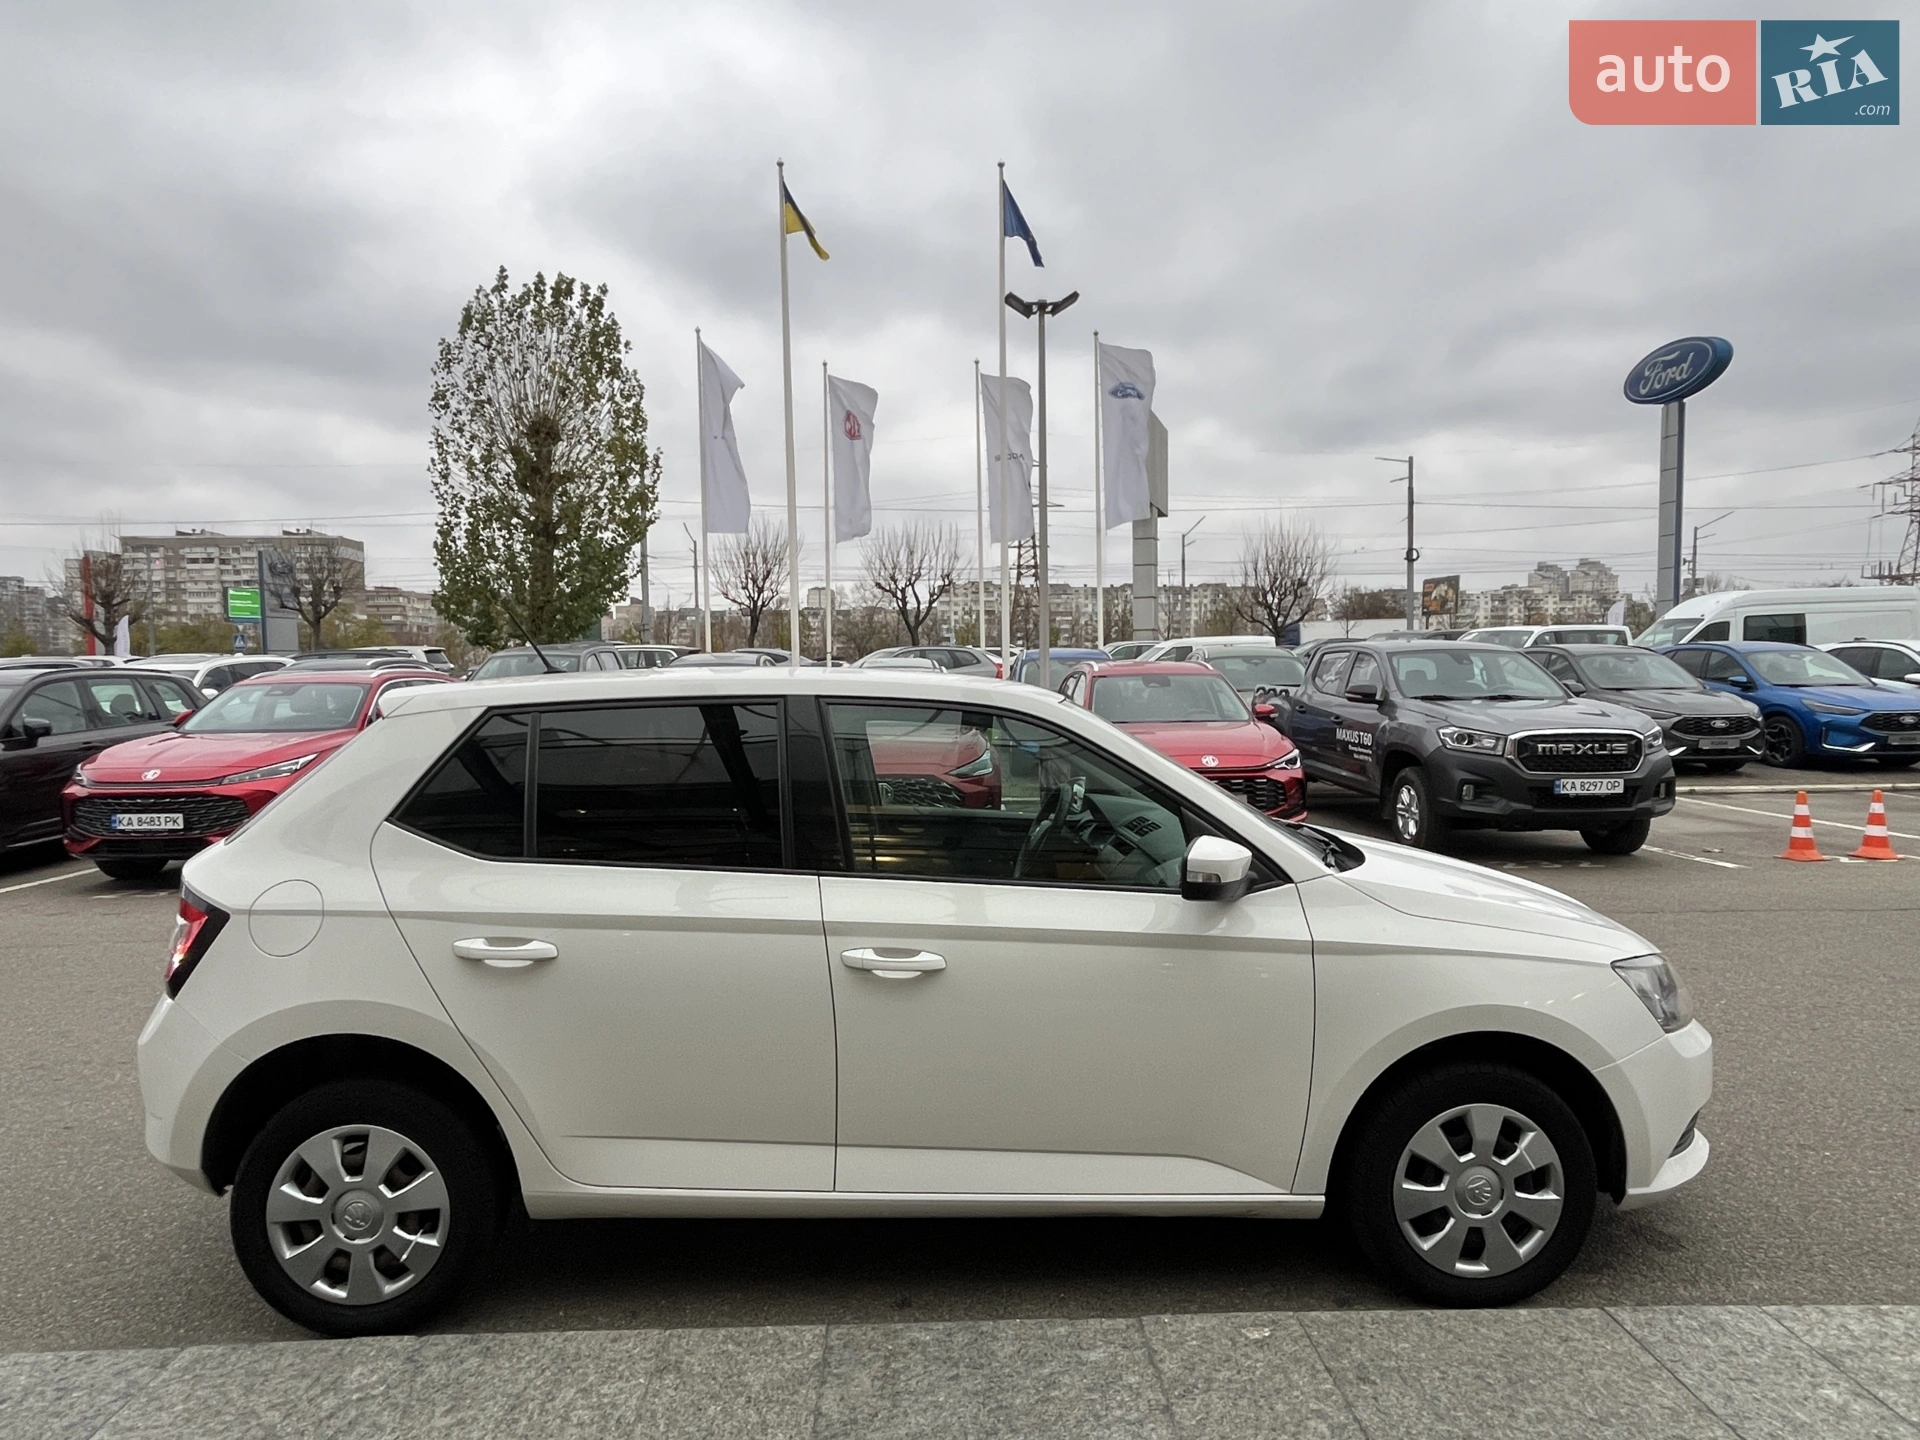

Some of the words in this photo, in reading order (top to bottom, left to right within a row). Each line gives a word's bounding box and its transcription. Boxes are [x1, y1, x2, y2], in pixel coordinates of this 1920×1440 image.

[1639, 351, 1695, 395] Ford
[1336, 728, 1359, 743] MAXUS
[1360, 732, 1372, 746] T60
[1537, 743, 1628, 755] MAXUS
[1562, 781, 1577, 791] KA
[1580, 781, 1604, 792] 8297
[1606, 781, 1620, 791] OP
[117, 816, 134, 828] KA
[137, 815, 162, 828] 8483
[164, 815, 181, 827] PK
